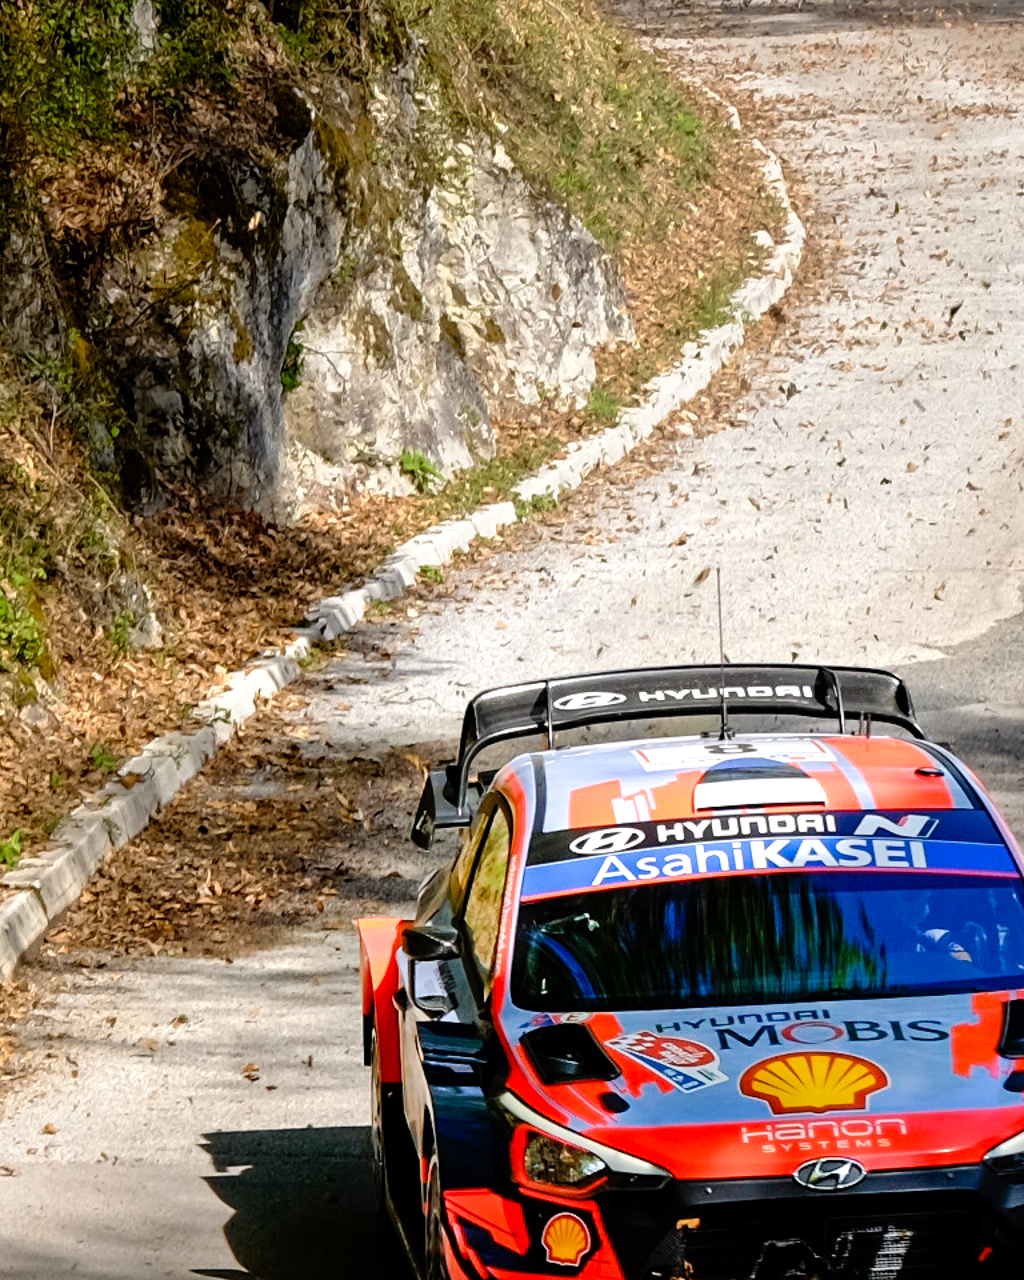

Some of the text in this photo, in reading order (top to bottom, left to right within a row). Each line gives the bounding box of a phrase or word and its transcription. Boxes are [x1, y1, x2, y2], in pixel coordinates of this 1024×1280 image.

[638, 685, 813, 702] HYUNDAI
[657, 814, 837, 843] HYUNDAI
[655, 1009, 831, 1034] HYUNDAI
[717, 1020, 950, 1050] MOBIS
[762, 1138, 891, 1153] SYSTEMS
